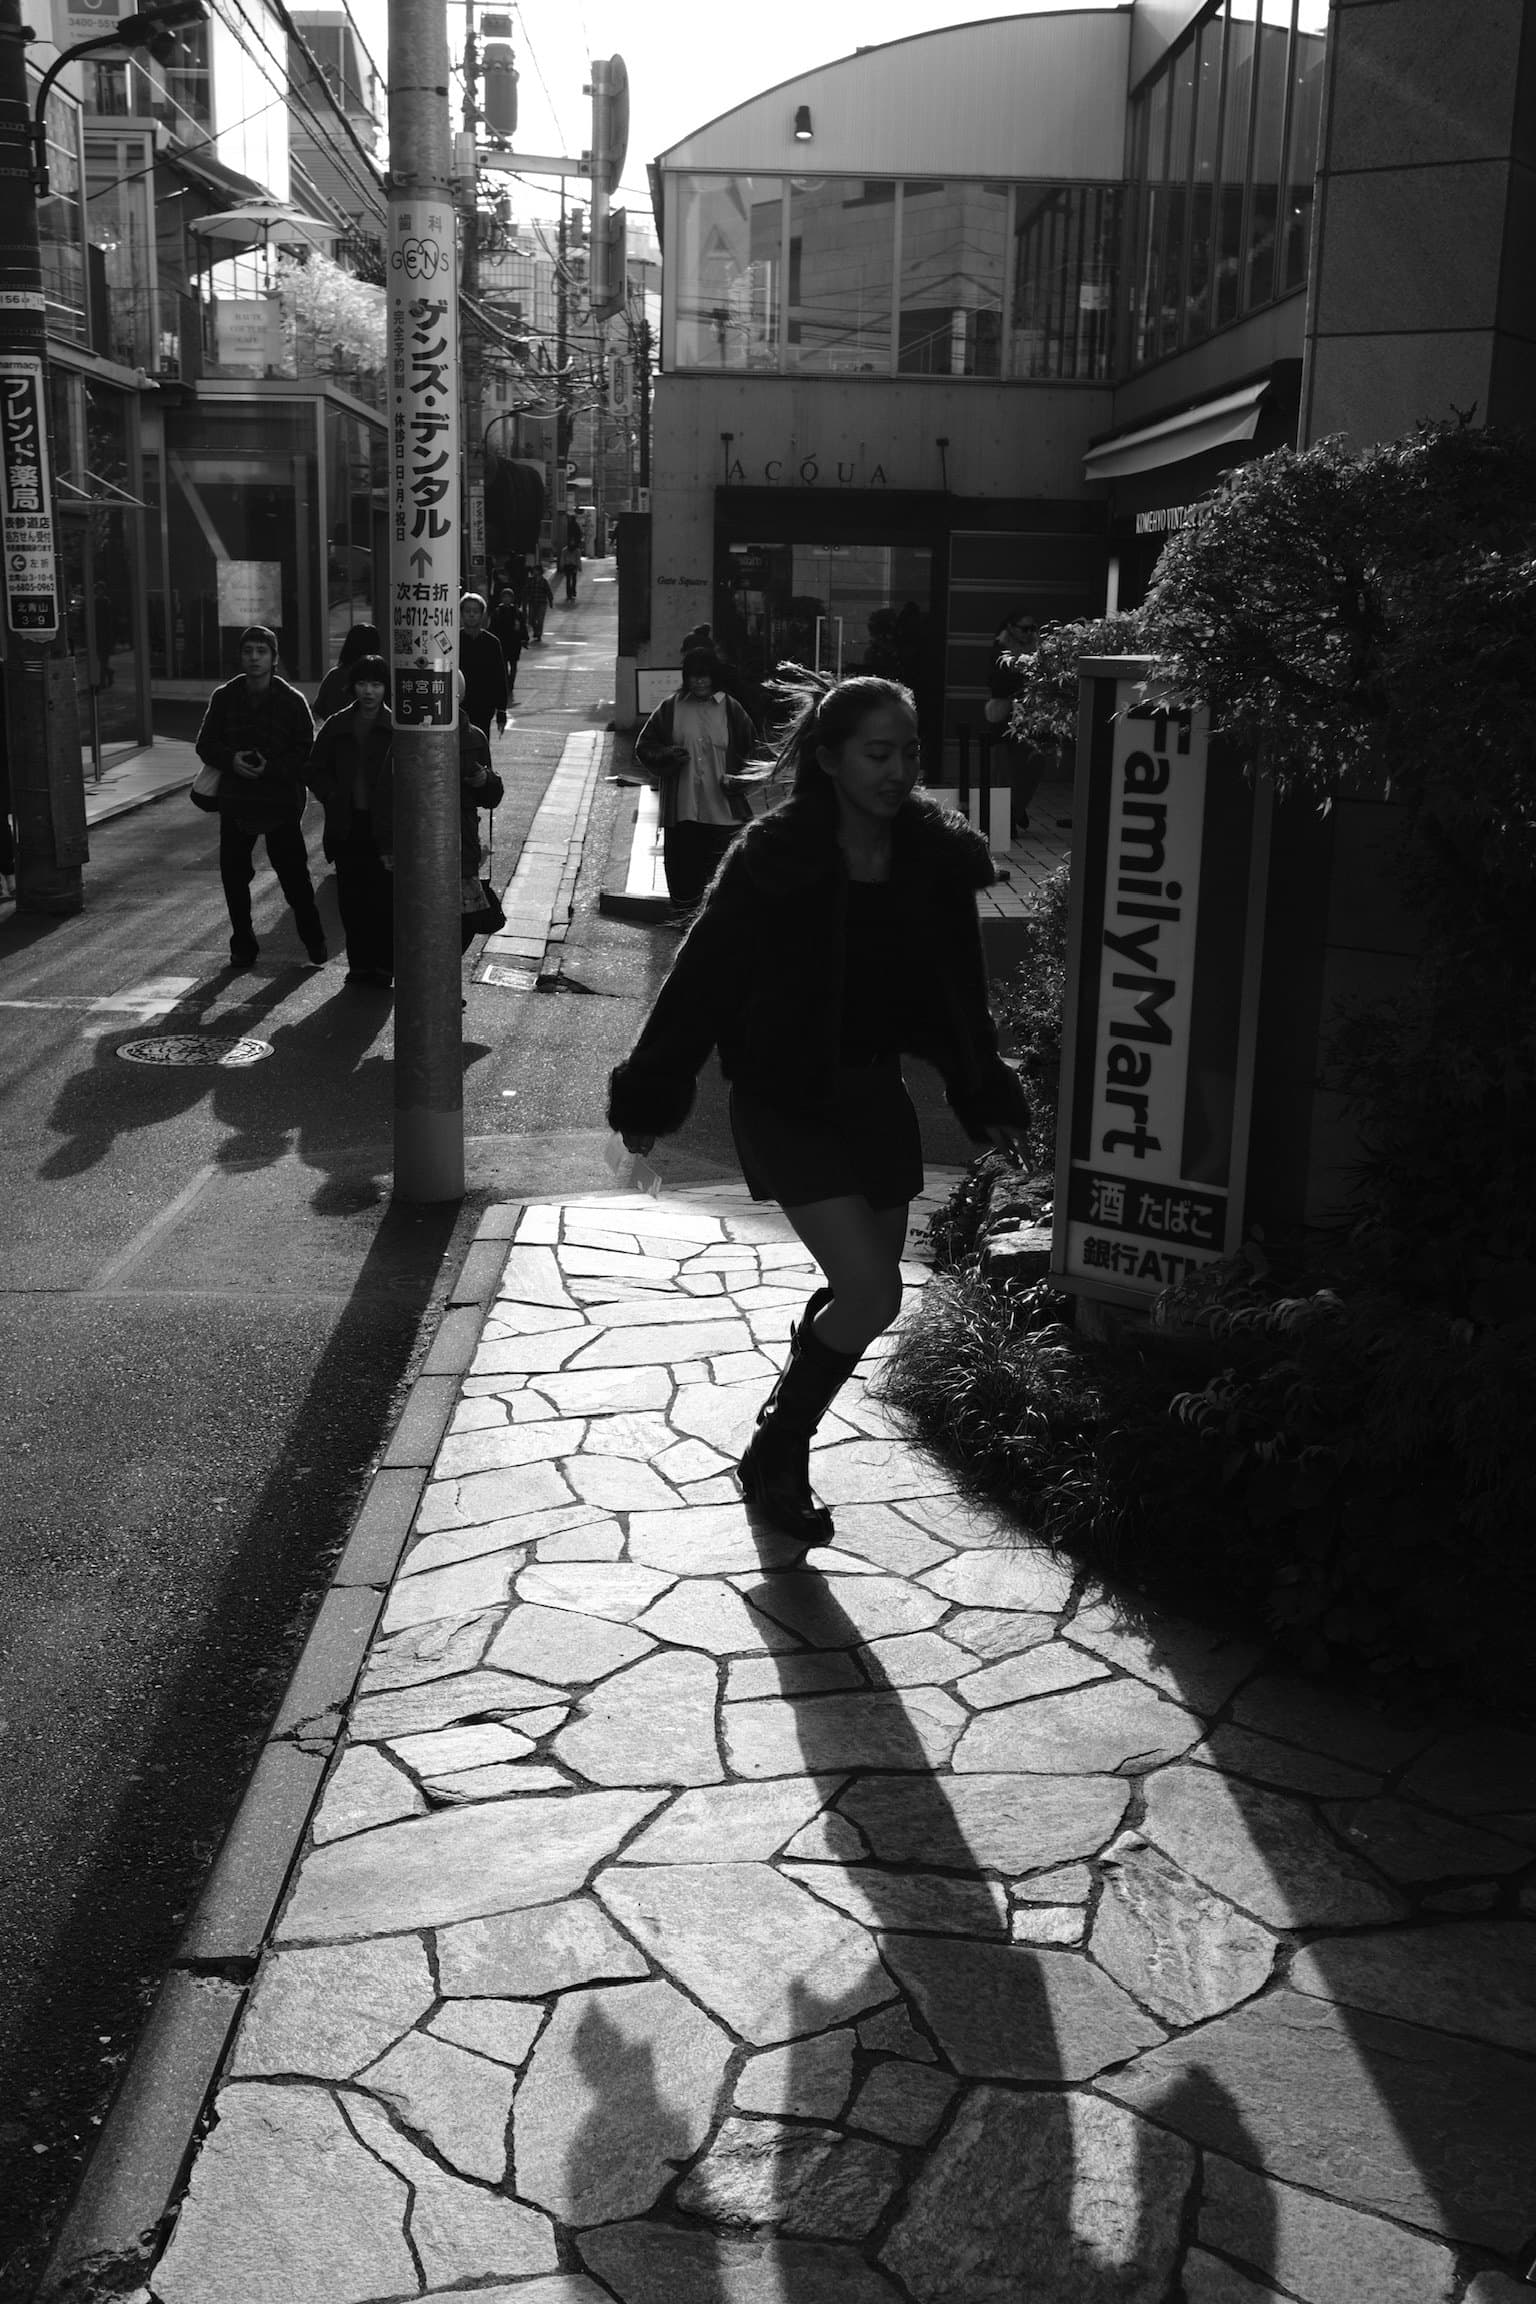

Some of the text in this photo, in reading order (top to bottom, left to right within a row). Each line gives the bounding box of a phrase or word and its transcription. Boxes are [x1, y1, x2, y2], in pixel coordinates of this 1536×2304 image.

[397, 214, 444, 233] 歯科
[409, 298, 452, 539] ゲンズ・デンタル
[396, 582, 449, 602] 次右折
[657, 576, 708, 588] Gate Square
[394, 607, 453, 627] 03-6712-5141
[401, 679, 446, 695] 神宮前
[1101, 699, 1192, 1159] FamilyMart
[1089, 1178, 1214, 1240] 酒 たばこ
